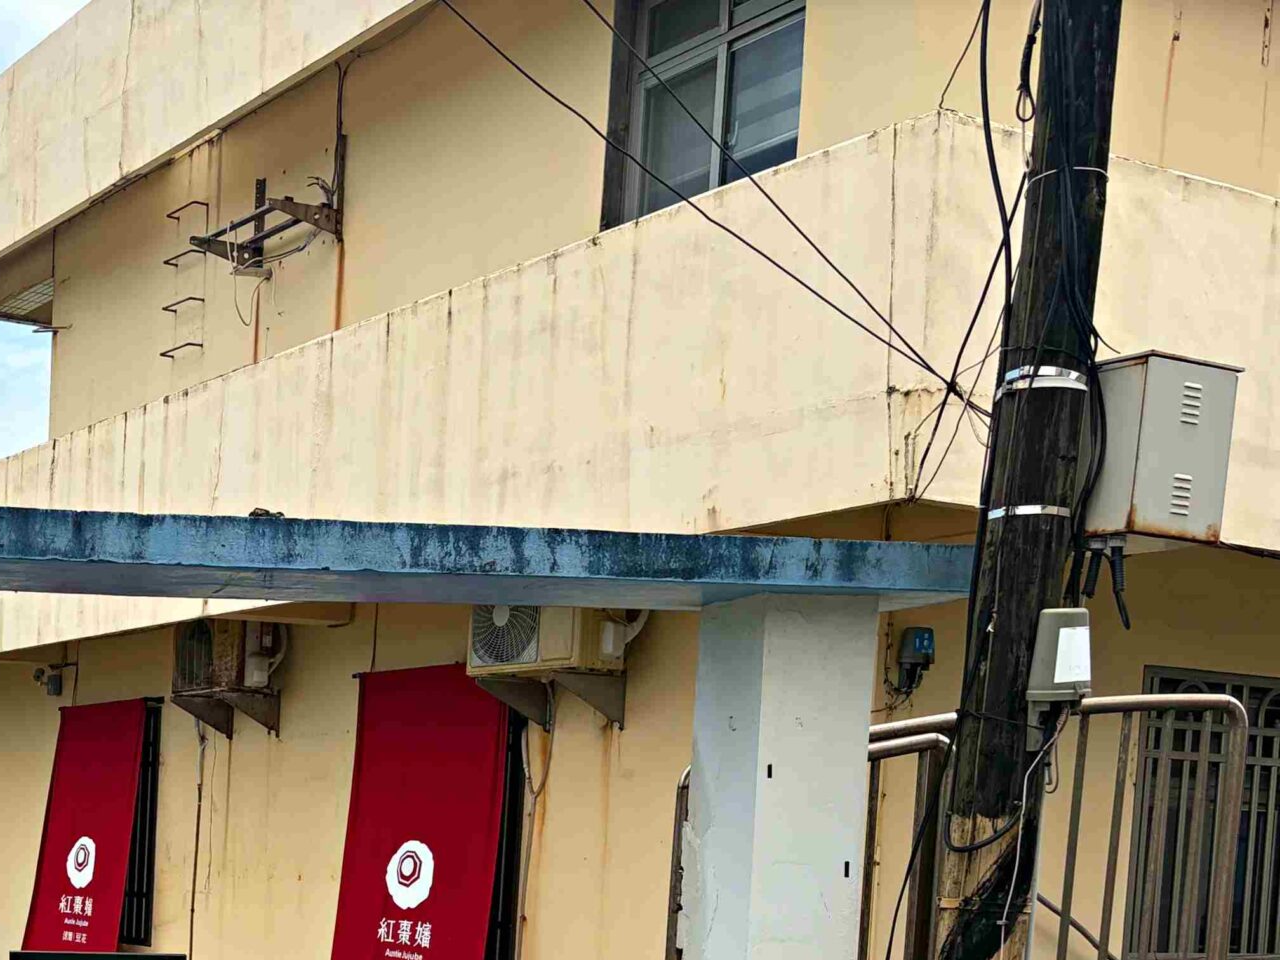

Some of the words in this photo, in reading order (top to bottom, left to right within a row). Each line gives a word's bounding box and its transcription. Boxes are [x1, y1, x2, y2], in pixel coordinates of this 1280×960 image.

[376, 916, 432, 949] 紅棗嬸
[384, 948, 402, 959] Auntie
